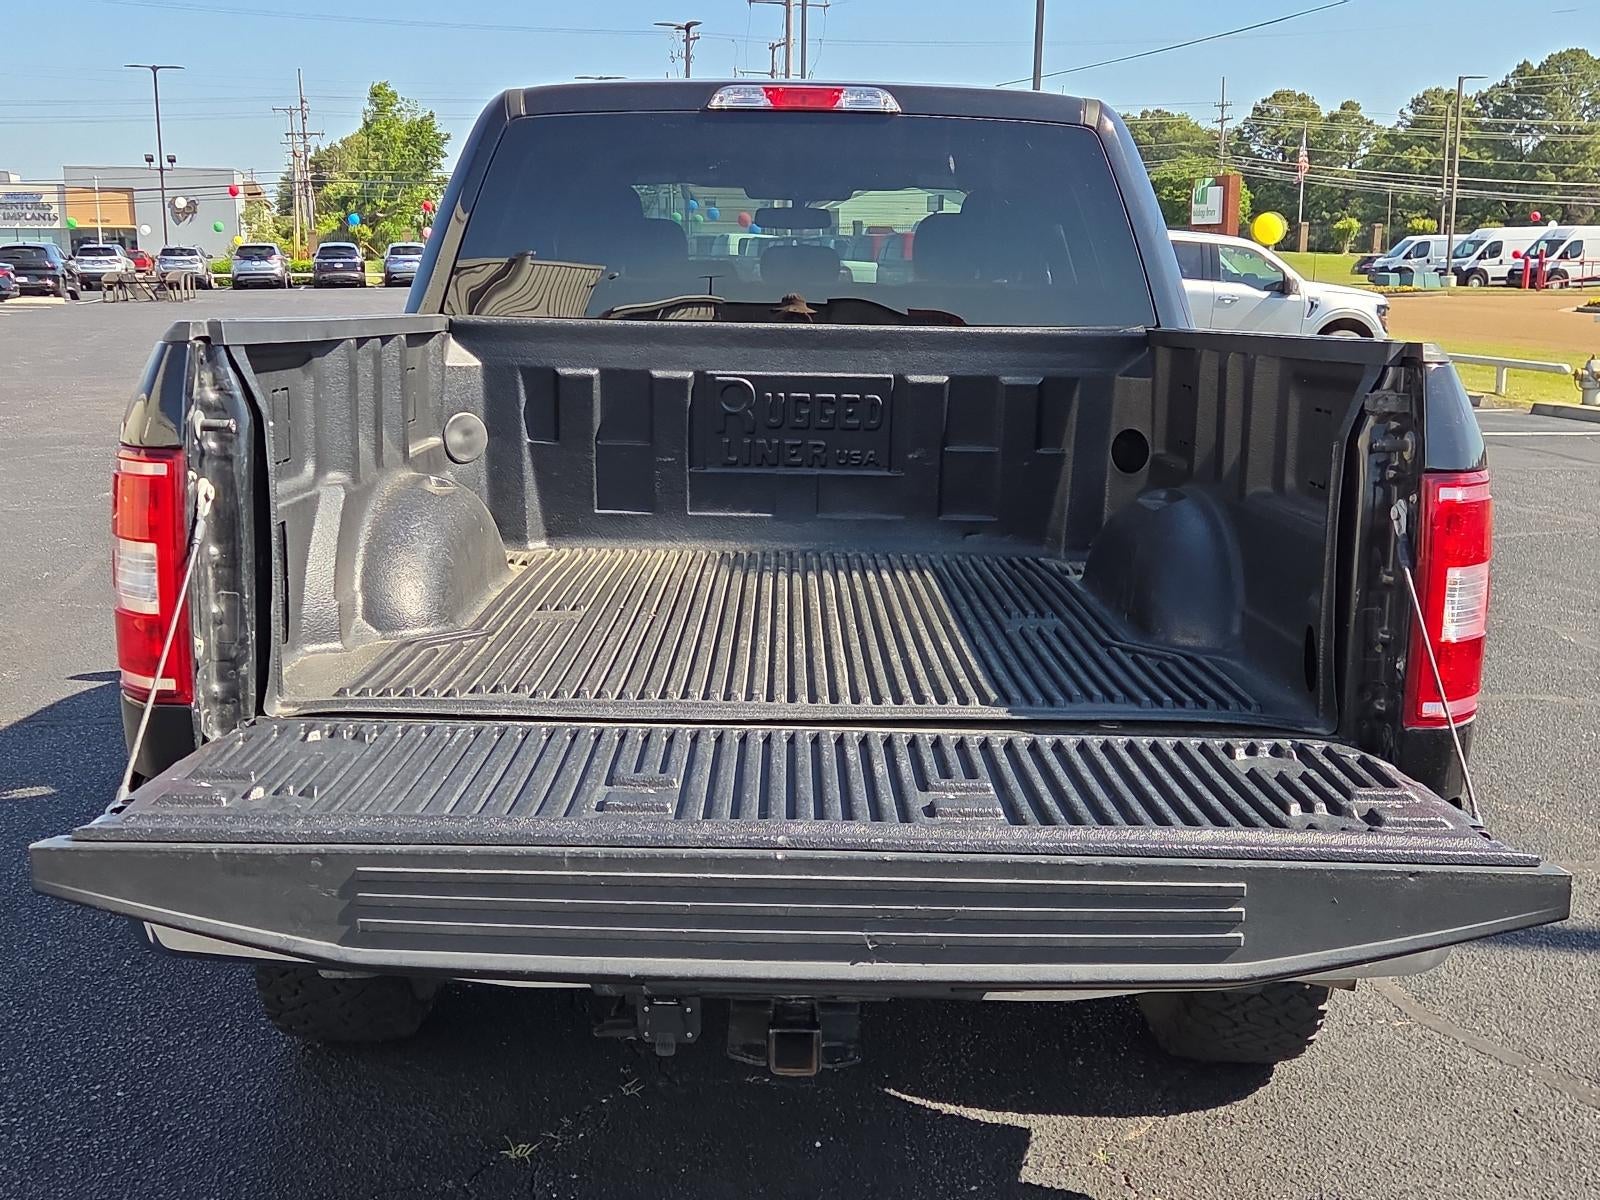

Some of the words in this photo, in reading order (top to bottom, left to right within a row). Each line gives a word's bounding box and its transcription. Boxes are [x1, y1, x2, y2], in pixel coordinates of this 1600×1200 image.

[2, 211, 59, 222] IMPLANTS
[715, 376, 884, 434] RUGGED
[720, 437, 828, 467] LINER
[835, 449, 881, 467] USA
